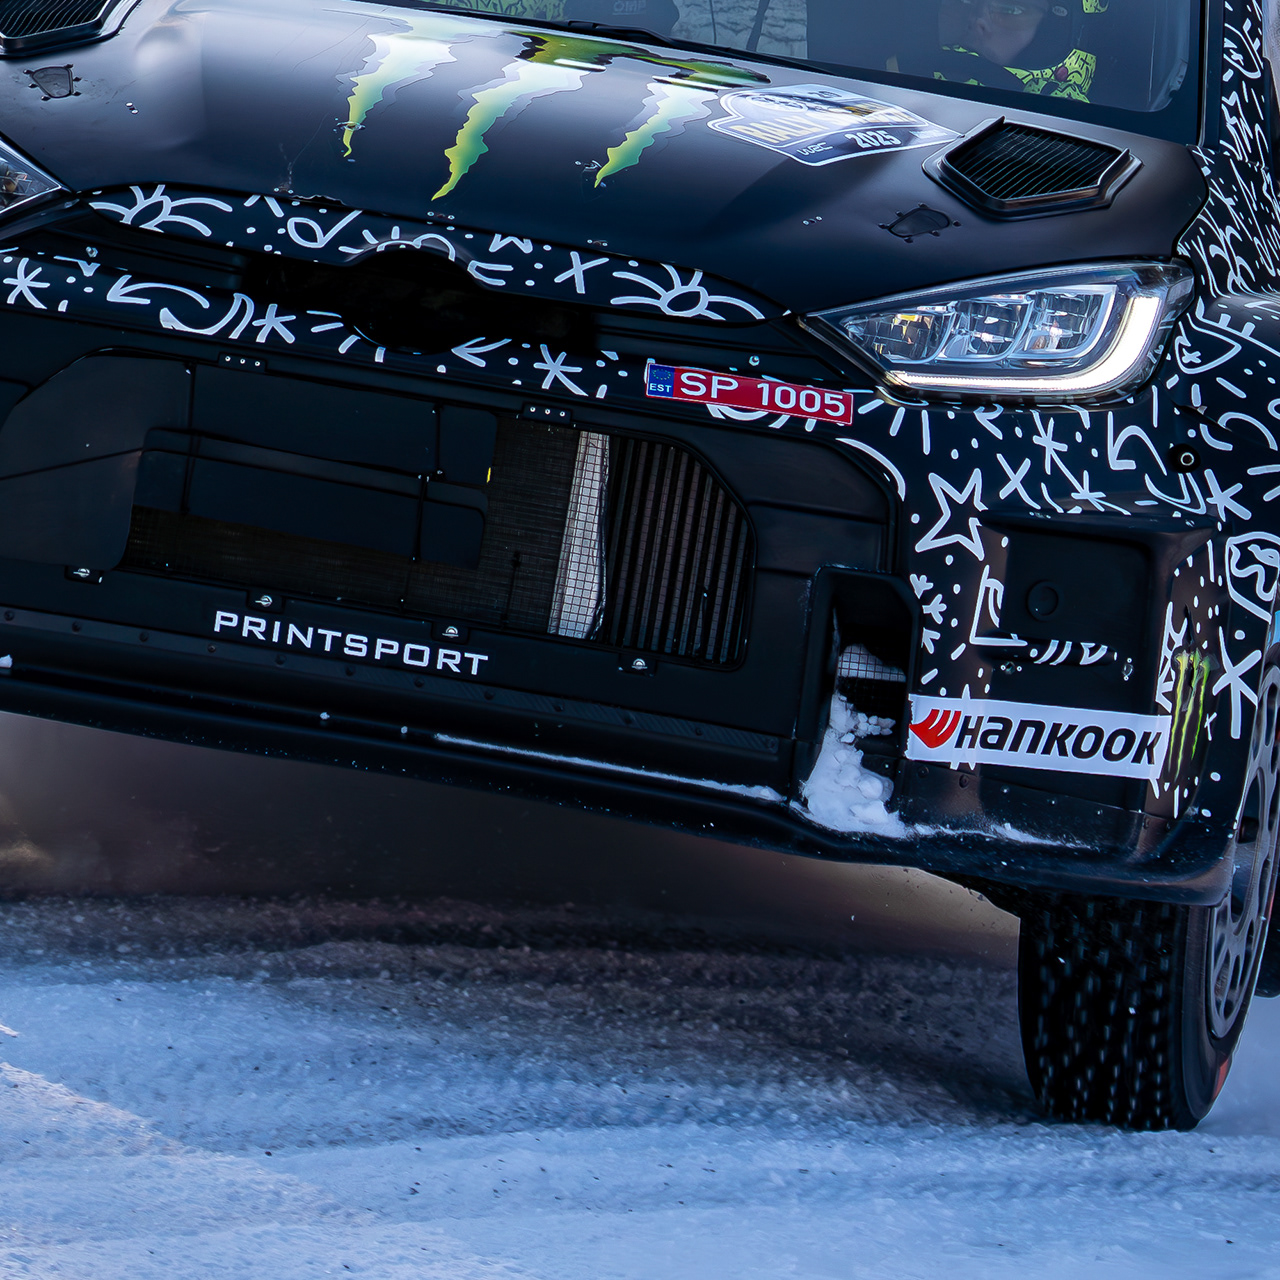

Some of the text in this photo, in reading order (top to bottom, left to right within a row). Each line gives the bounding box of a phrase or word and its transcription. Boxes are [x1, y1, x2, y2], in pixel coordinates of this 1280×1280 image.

[730, 114, 830, 144] RALLY
[844, 130, 902, 150] 2025
[649, 383, 672, 394] EST
[680, 372, 845, 418] SP 1005
[213, 610, 489, 676] PRINTSPORT
